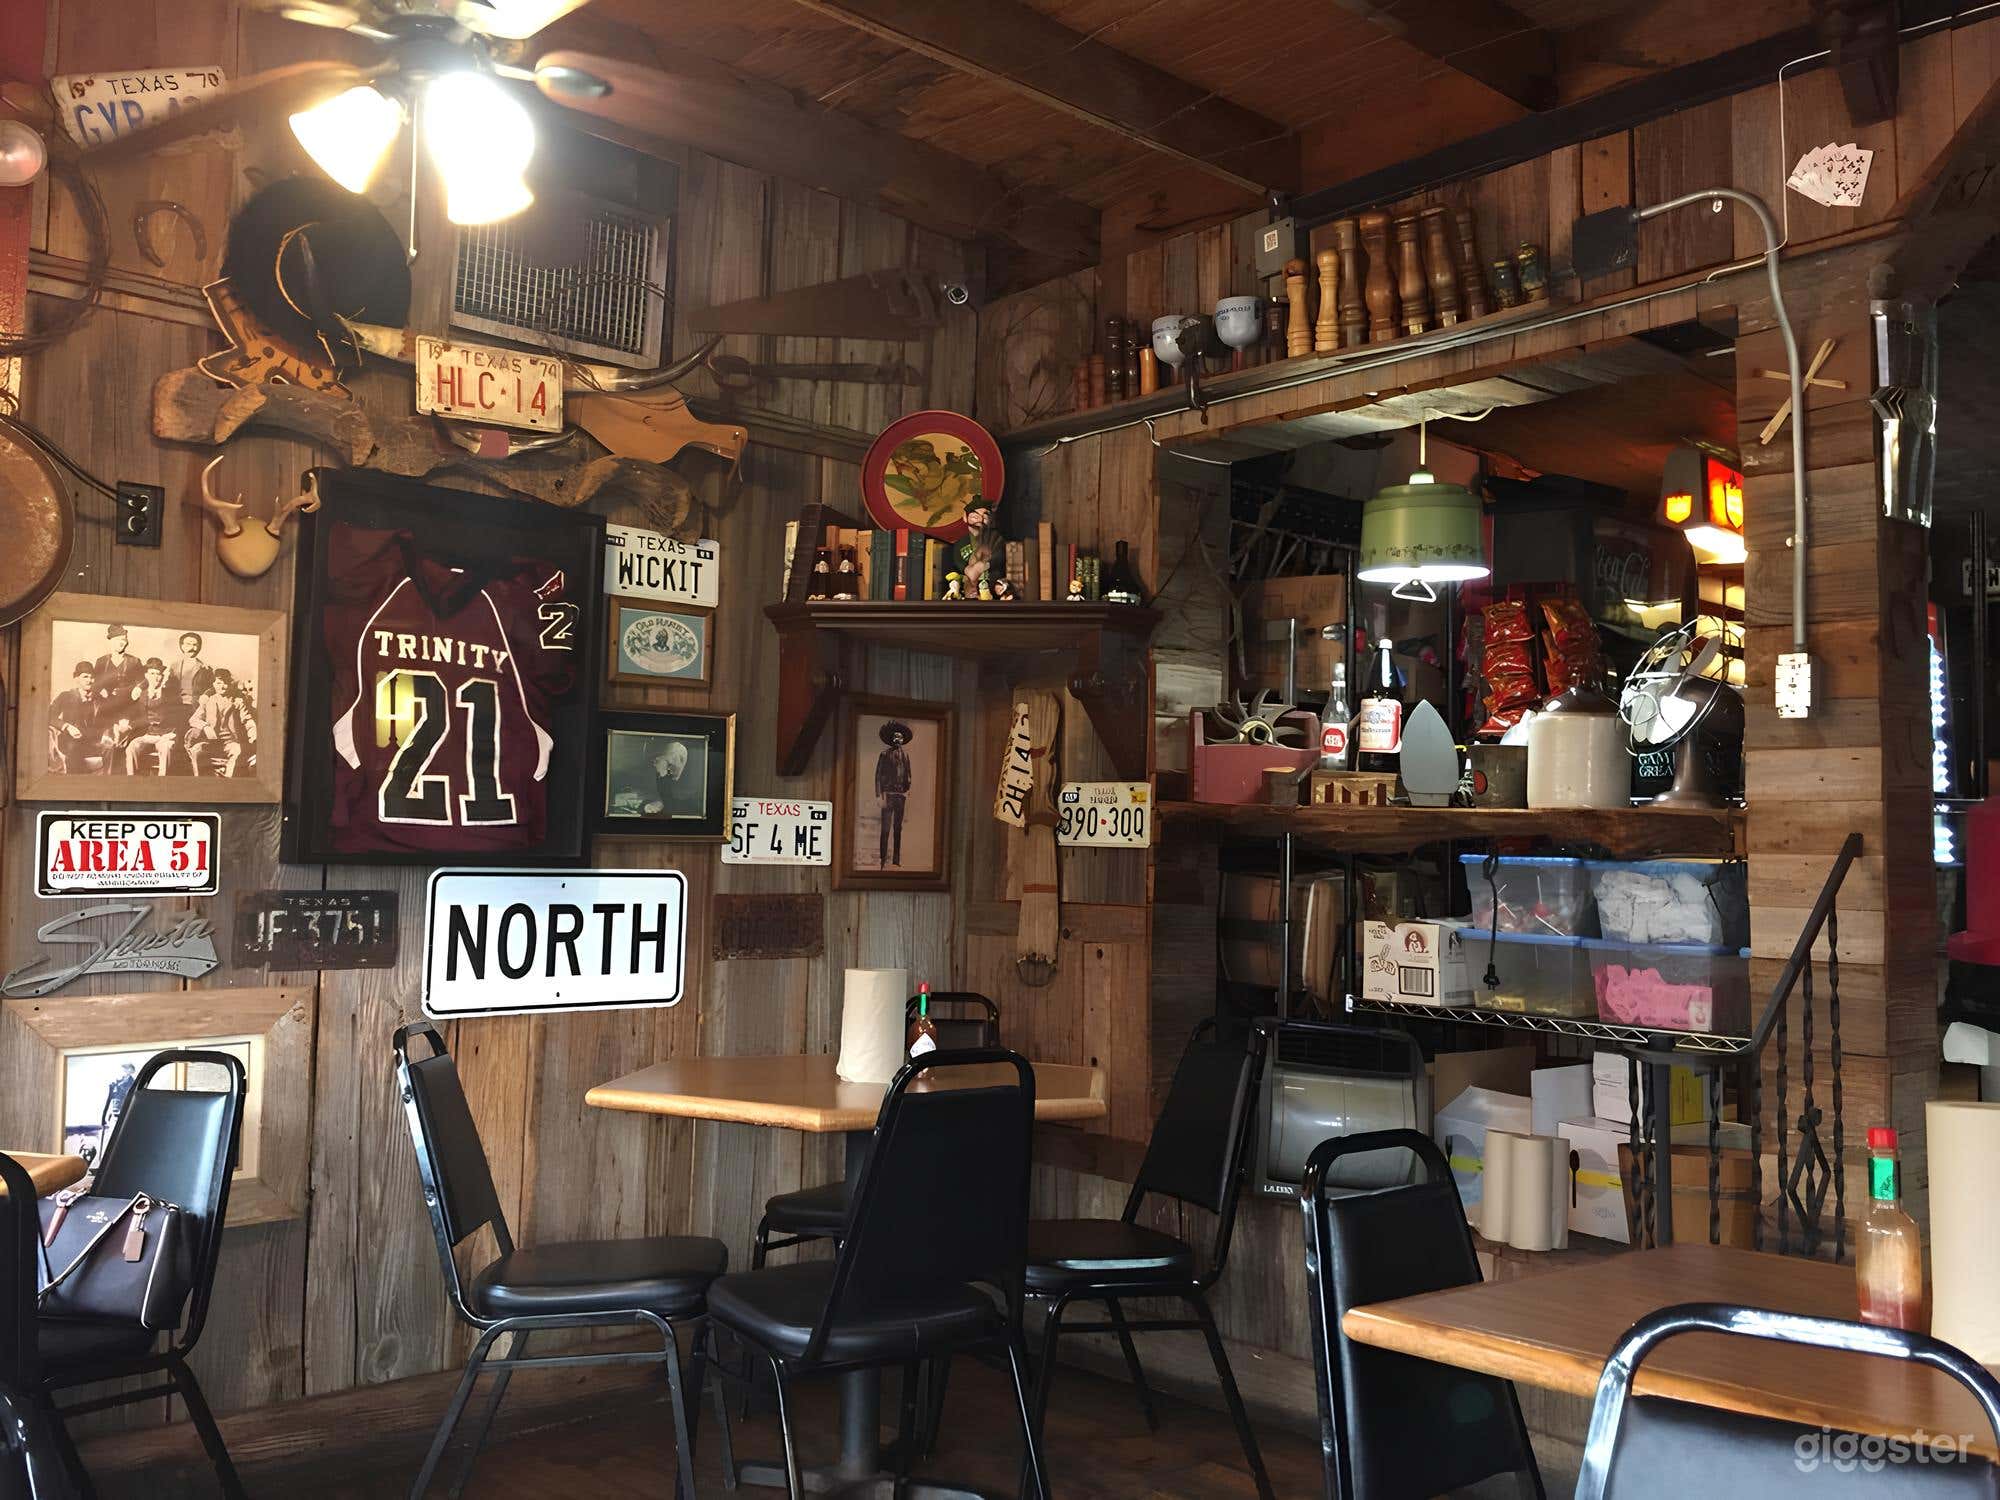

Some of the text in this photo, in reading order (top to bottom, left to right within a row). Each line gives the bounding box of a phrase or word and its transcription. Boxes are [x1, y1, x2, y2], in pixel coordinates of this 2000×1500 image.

[106, 75, 179, 95] TEXAS
[461, 350, 522, 374] TEXAS
[637, 535, 686, 555] TEXAS
[619, 551, 703, 593] WICKIT
[374, 630, 509, 674] TRINITY
[376, 668, 517, 826] 21
[758, 802, 801, 816] TEXAS
[70, 822, 193, 840] KEEP OUT
[731, 822, 822, 856] SF 4 ME
[50, 840, 208, 872] AREA 51
[285, 897, 351, 906] TEXAS
[446, 902, 668, 981] NORTH
